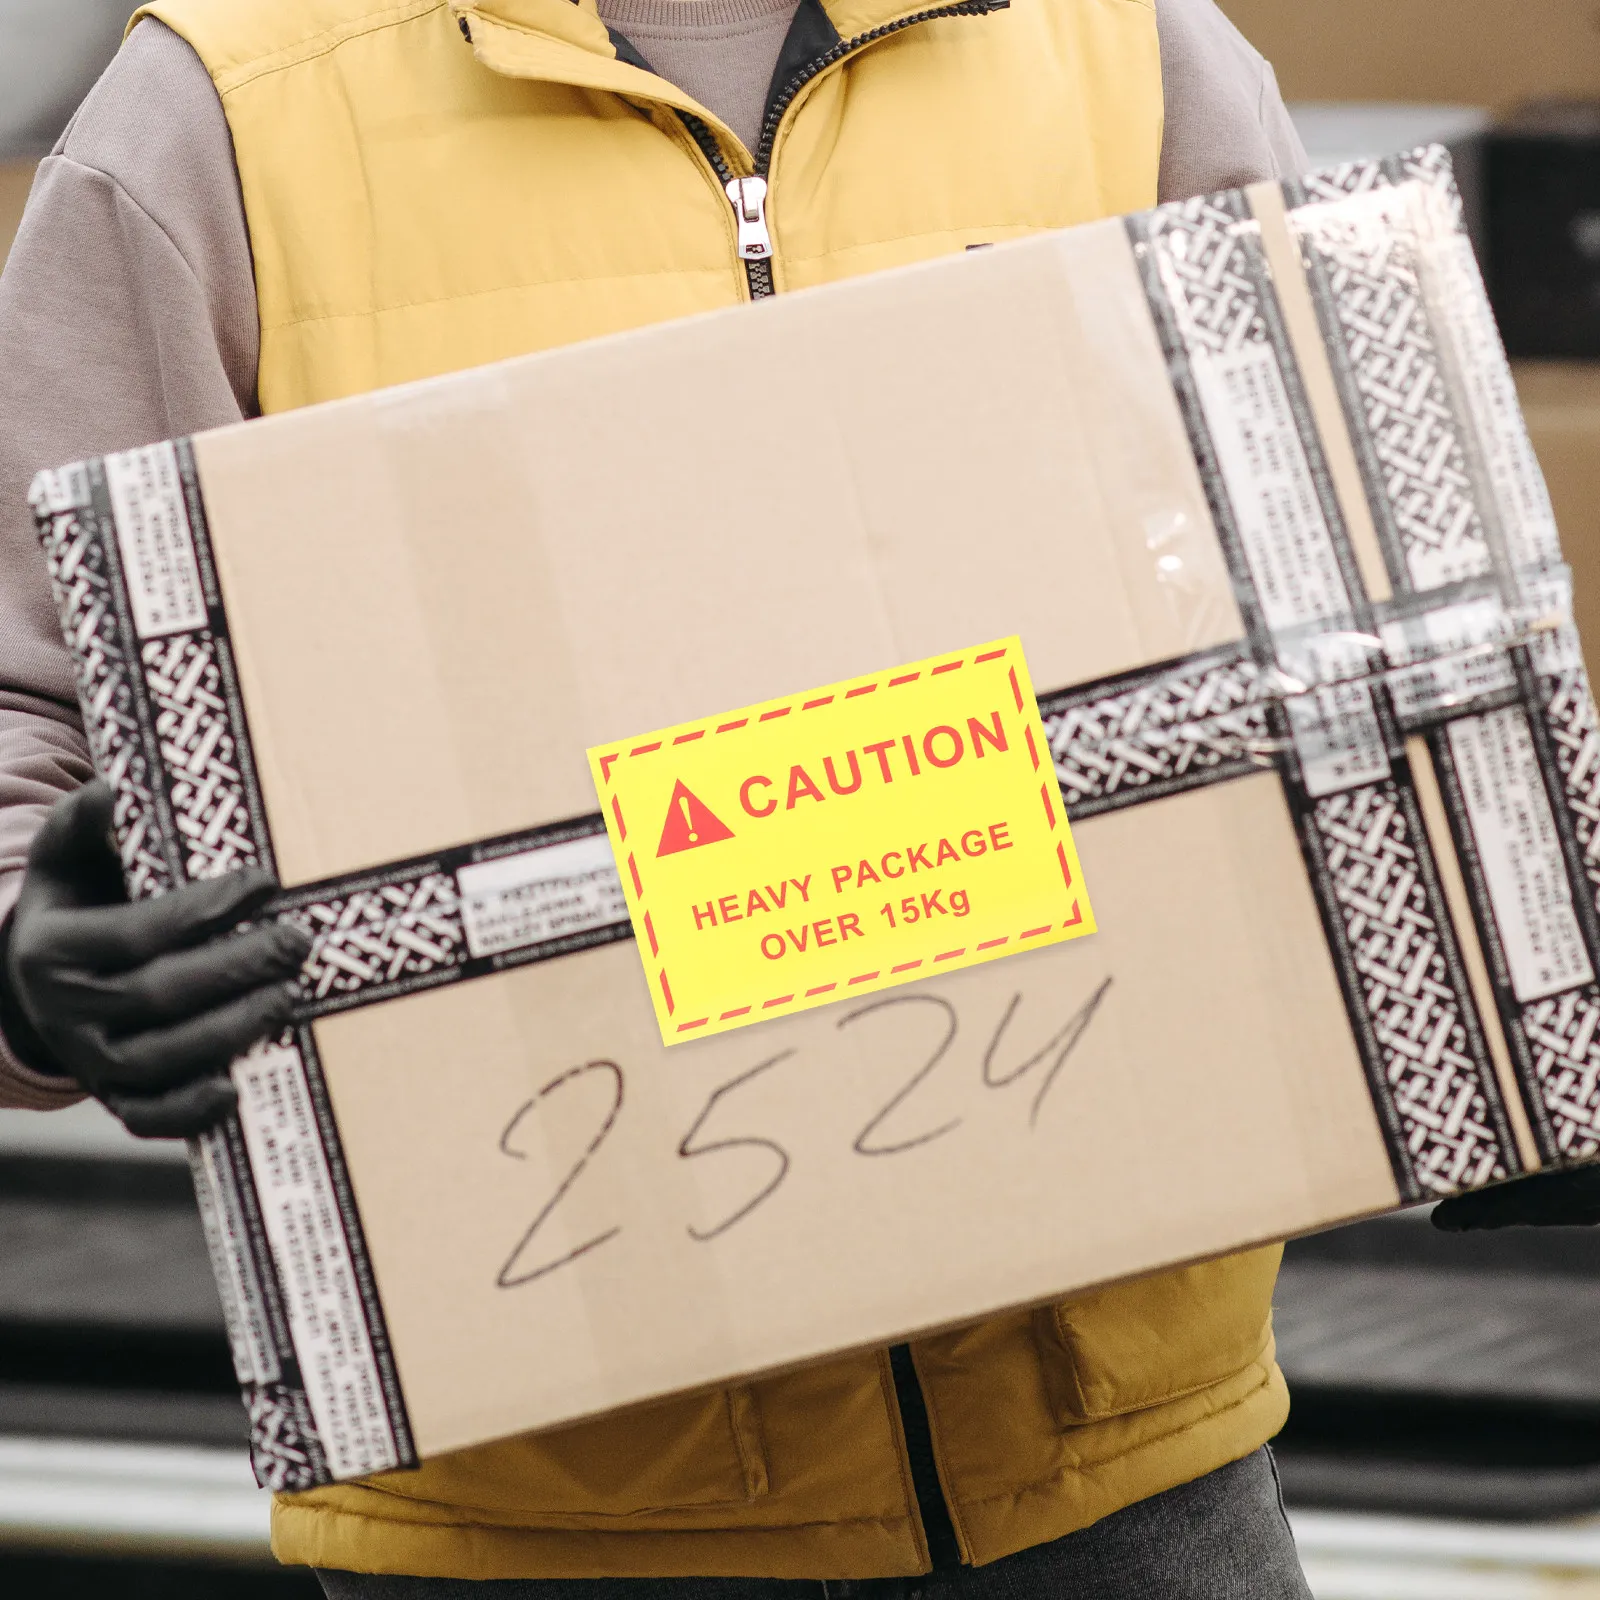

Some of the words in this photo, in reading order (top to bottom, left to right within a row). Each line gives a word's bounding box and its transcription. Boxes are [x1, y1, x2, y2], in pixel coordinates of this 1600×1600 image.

[739, 711, 1009, 819] CAUTION
[691, 874, 811, 931] HEAVY
[831, 821, 1014, 893] PACKAGE
[760, 912, 864, 960] OVER
[880, 889, 971, 928] 15Kg
[495, 974, 1113, 1289] 2524
